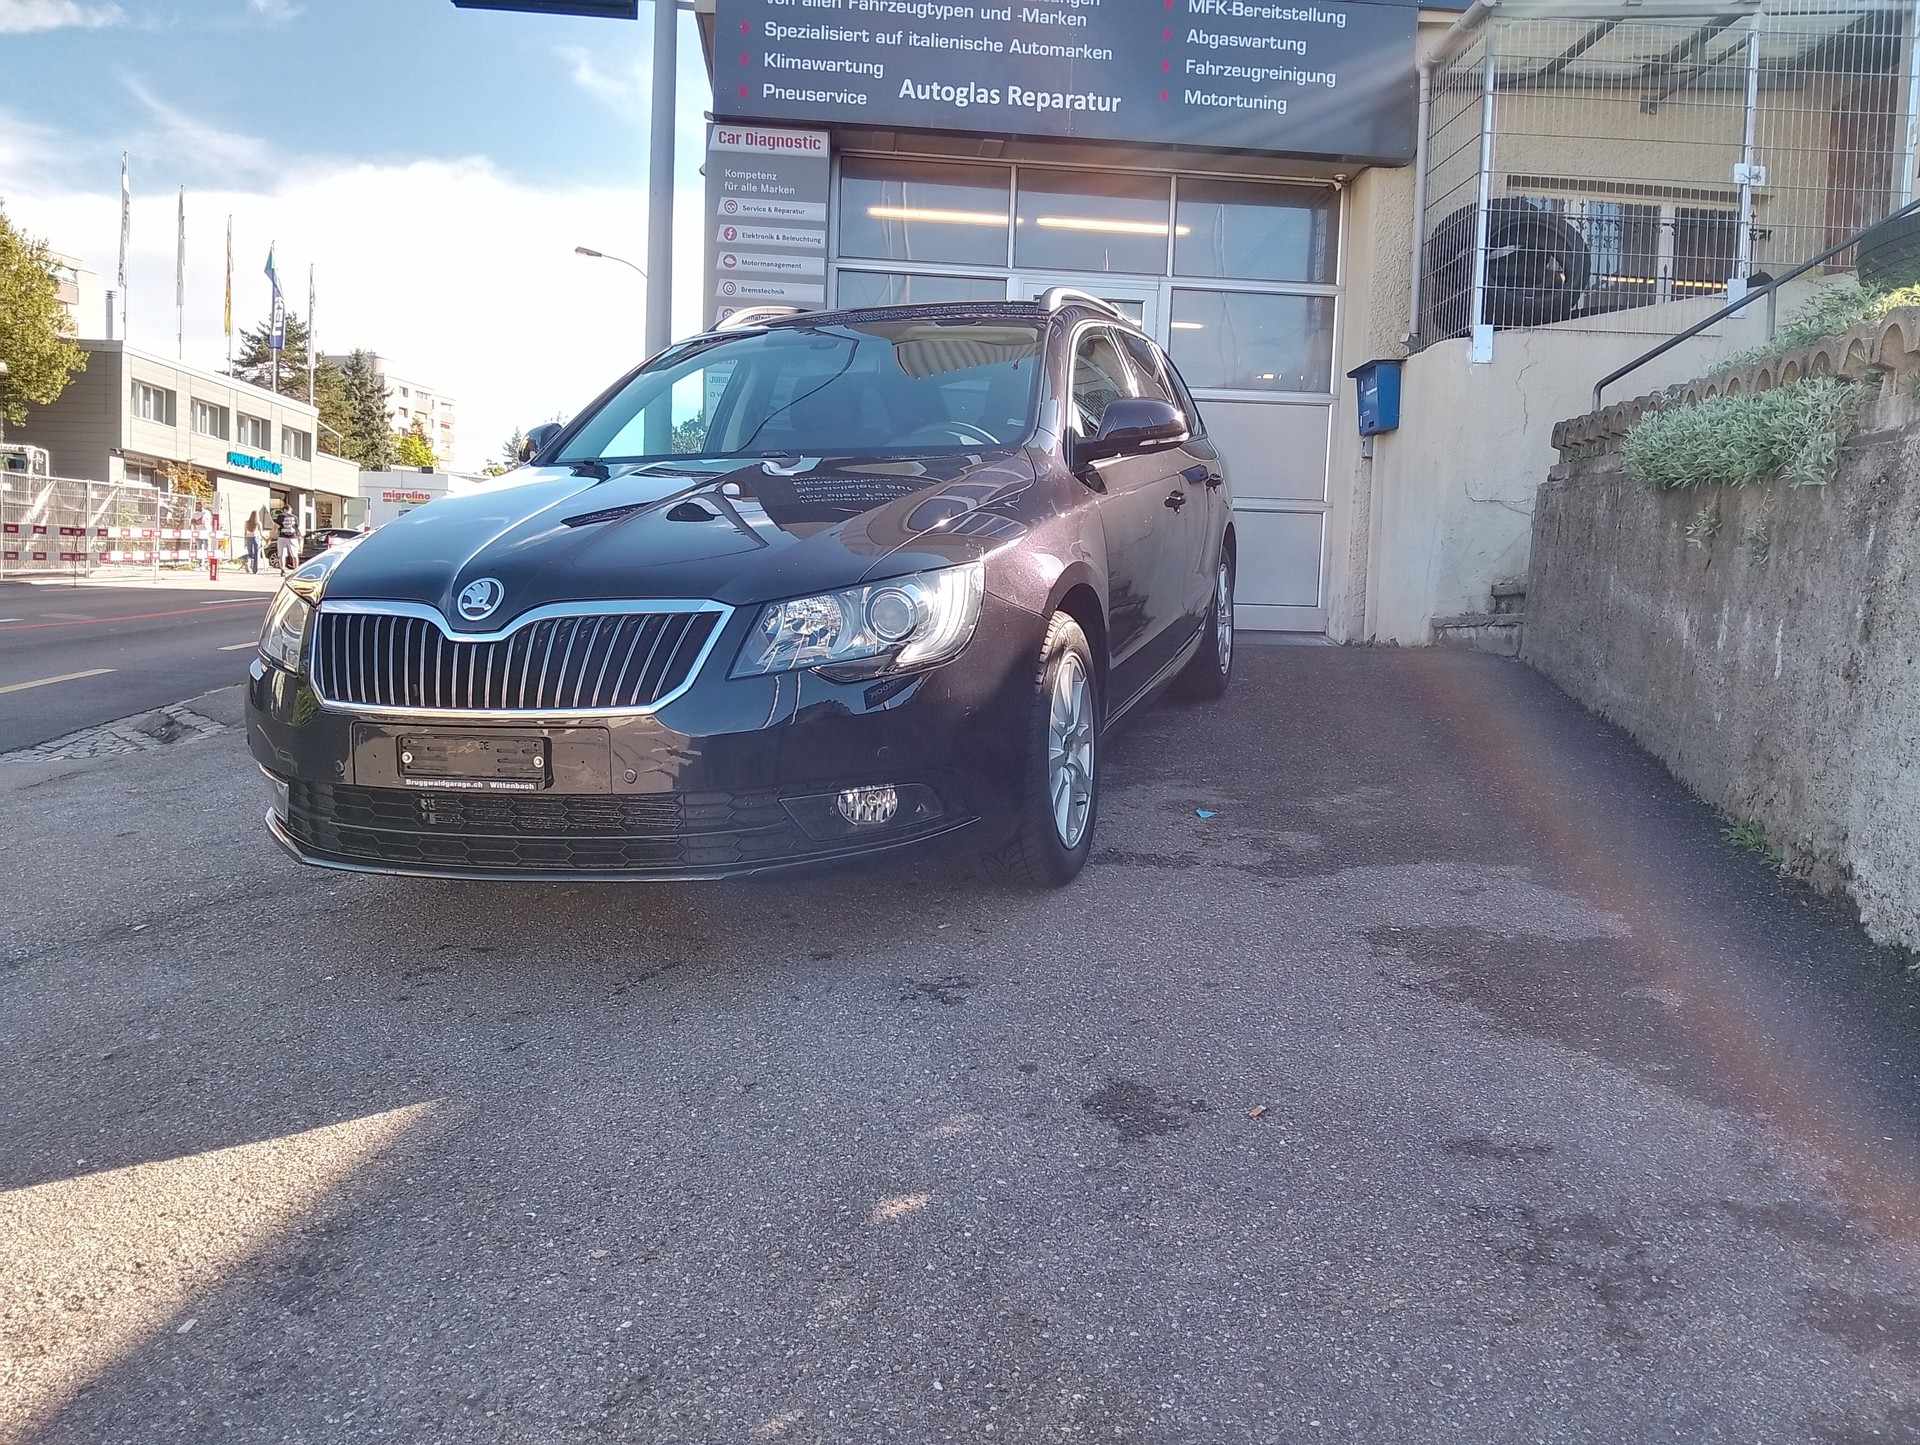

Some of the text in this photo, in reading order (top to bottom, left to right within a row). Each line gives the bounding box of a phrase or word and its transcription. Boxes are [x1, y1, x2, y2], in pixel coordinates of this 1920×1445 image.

[802, 0, 842, 9] allen
[849, 0, 974, 20] Fahrzeugtypen
[980, 6, 1012, 22] und
[1017, 7, 1087, 27] -Marken
[1188, 0, 1347, 29] MFK-Bereitstellung
[764, 20, 1113, 61] Spezialisiert auf italienische Automarken
[1186, 28, 1307, 56] Abgaswartung
[763, 52, 884, 79] Klimawartung
[1185, 59, 1337, 88] Fahrzeugreinigung
[762, 83, 868, 105] Pneuservice
[898, 78, 1122, 113] Autoglas Reparatur
[1184, 89, 1288, 115] Motortuning
[718, 130, 822, 151] Car Diagnostic
[724, 168, 778, 181] Kompetenz
[724, 181, 796, 195] für alle Marken
[742, 205, 767, 213] Service
[773, 206, 806, 216] Reparatur
[741, 232, 775, 241] Elektronik
[781, 234, 822, 245] Beleuchtung
[741, 259, 802, 270] Motormanagement
[740, 286, 785, 296] Bremstechnik
[382, 490, 431, 501] migrolino
[405, 779, 535, 790] Bruggwaldgarage.ch Wittenbach
